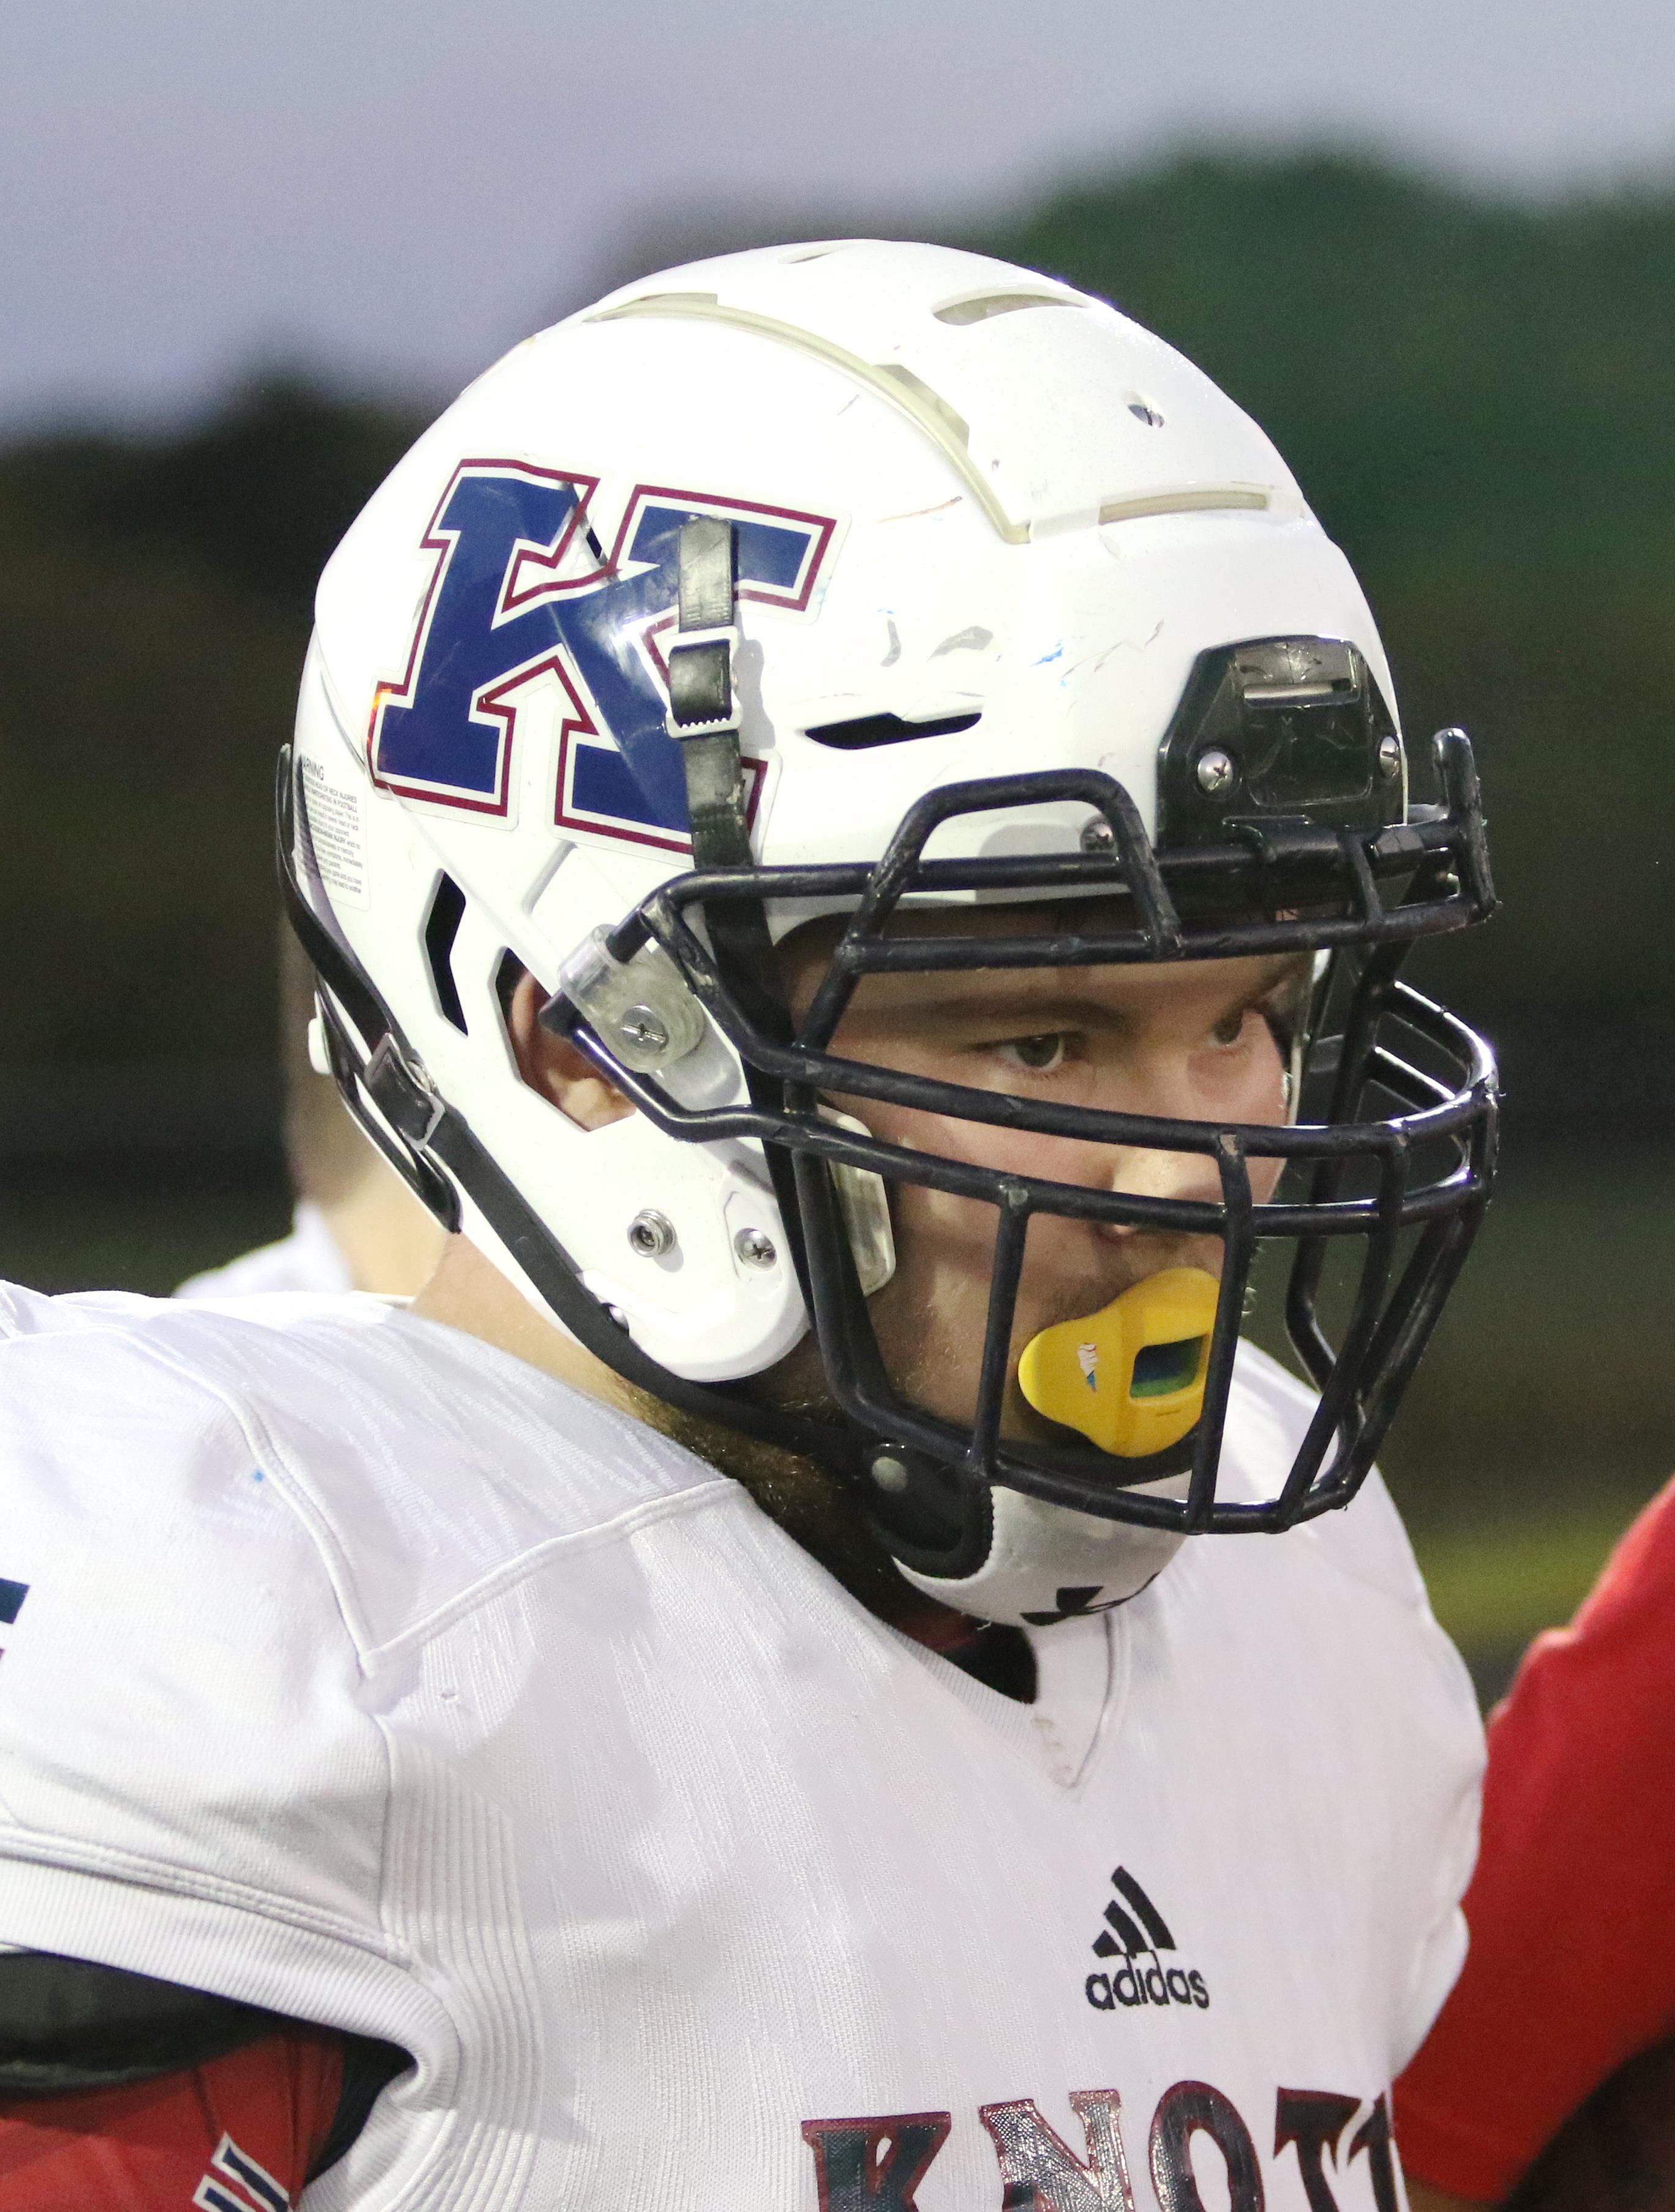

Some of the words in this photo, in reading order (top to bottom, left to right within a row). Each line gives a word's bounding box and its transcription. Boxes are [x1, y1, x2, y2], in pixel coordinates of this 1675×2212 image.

[367, 459, 837, 855] K
[337, 800, 358, 813] FOOTBALL
[339, 791, 358, 803] INJURIES
[1085, 1952, 1210, 2010] adidas
